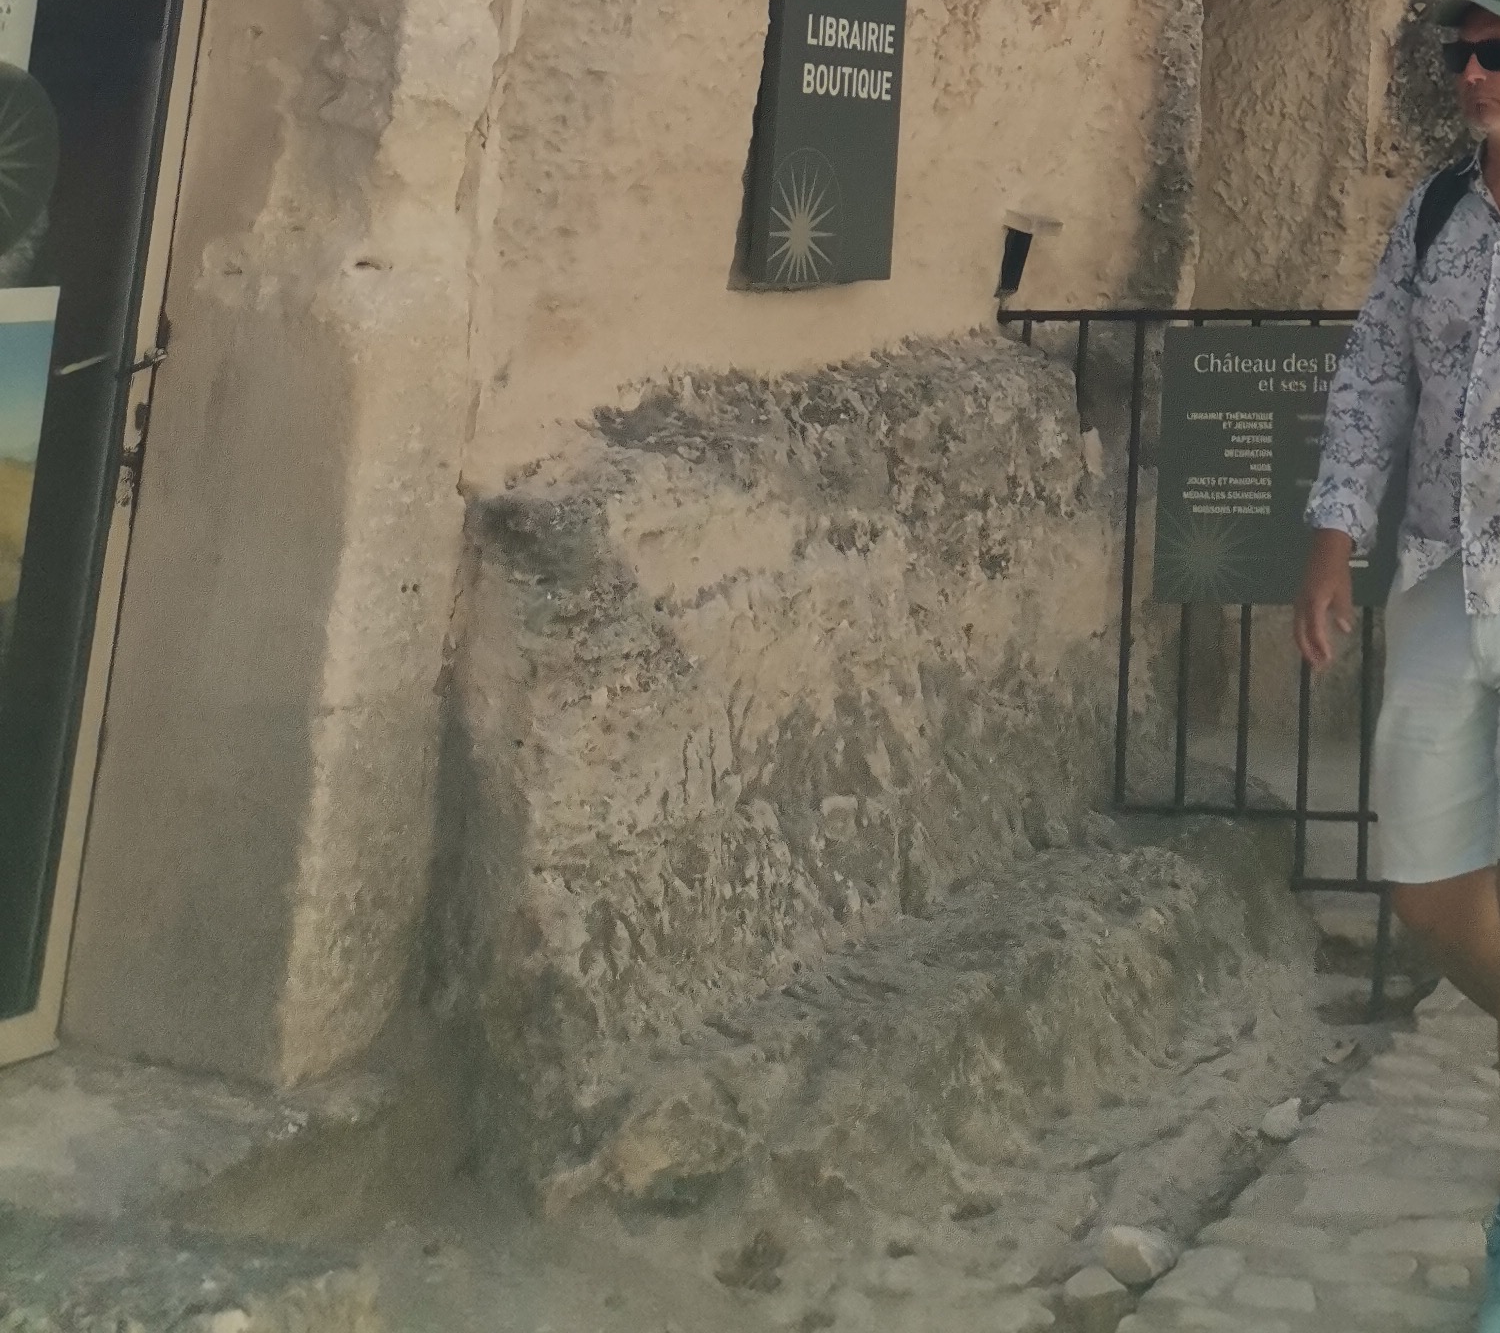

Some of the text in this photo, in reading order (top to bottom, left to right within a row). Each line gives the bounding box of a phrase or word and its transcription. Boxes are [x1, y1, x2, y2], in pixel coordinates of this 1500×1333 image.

[807, 13, 896, 55] LIBRAIRIE
[802, 62, 893, 101] BOUTIQUE
[1193, 352, 1277, 373] Château
[1282, 352, 1318, 373] des
[1258, 376, 1274, 392] et
[1280, 379, 1307, 392] ses
